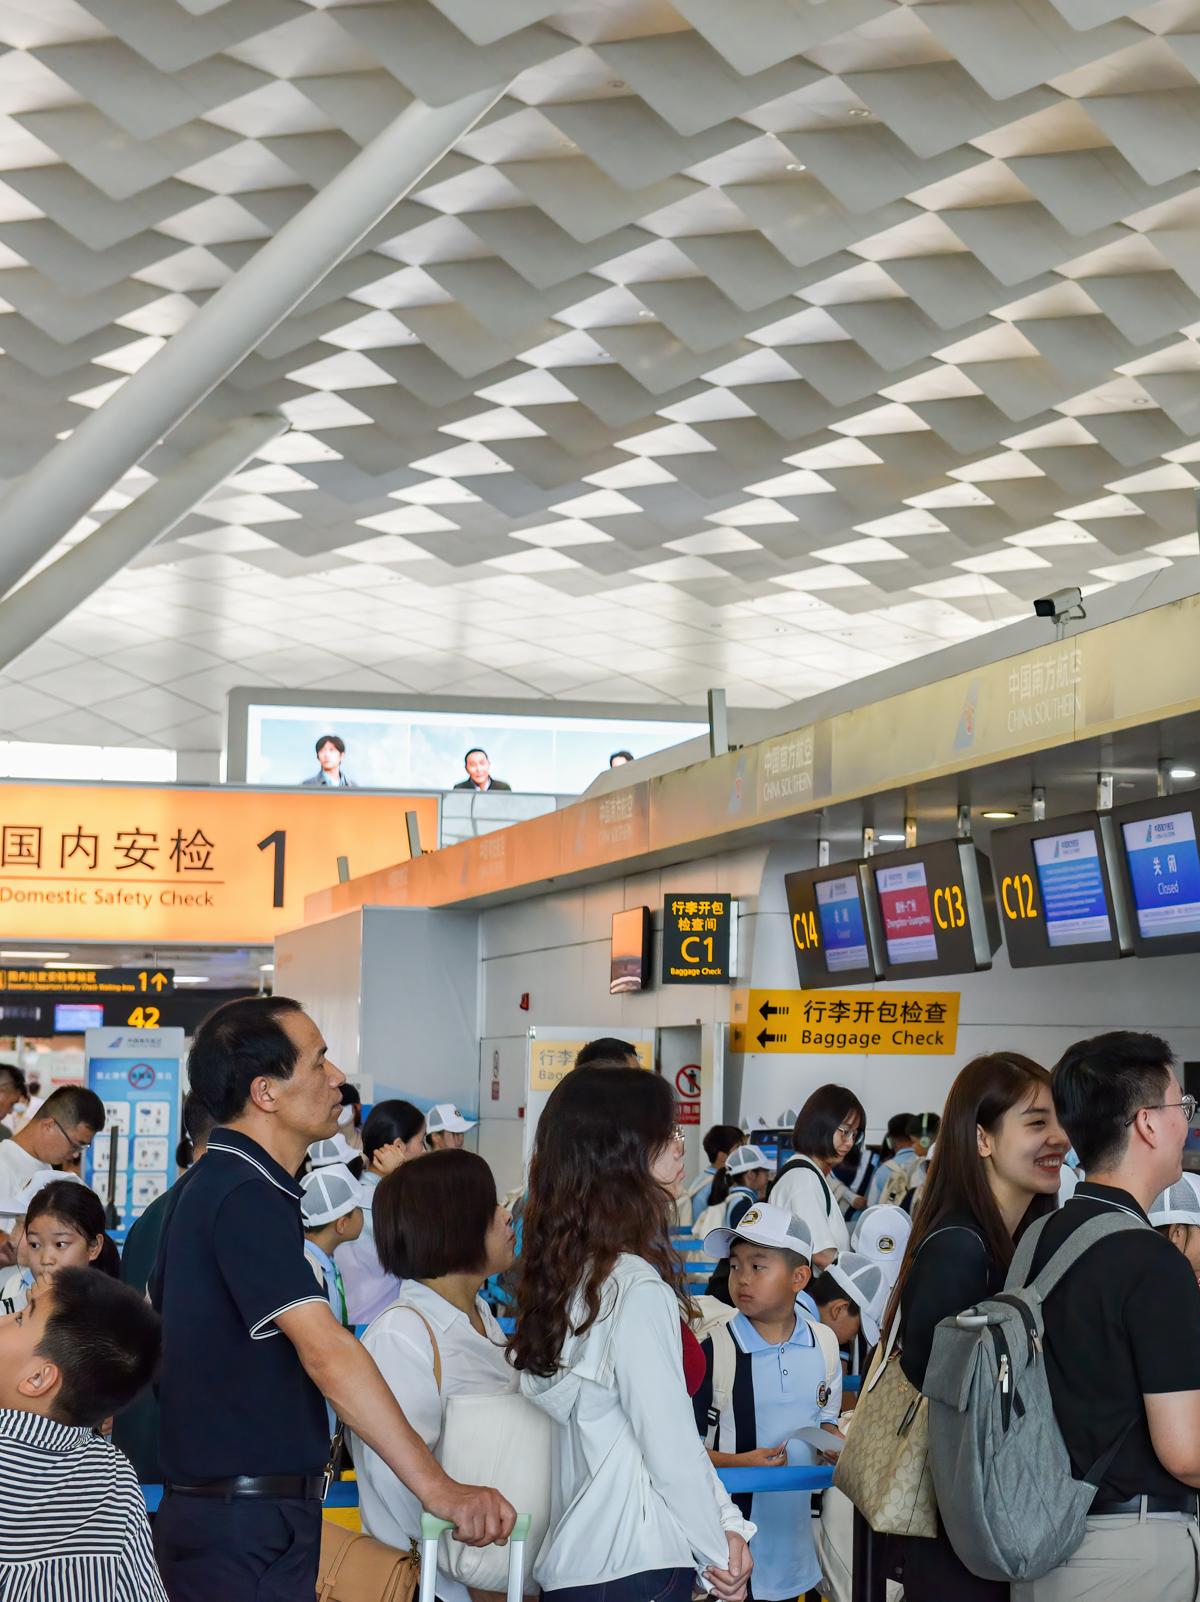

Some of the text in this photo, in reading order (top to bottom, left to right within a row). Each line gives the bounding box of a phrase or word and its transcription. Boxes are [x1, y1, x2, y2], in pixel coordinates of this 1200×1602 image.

[1008, 649, 1083, 704] 中国南方航空
[1007, 693, 1082, 733] CHINA SOUTHERN
[1, 824, 215, 873] 国内安检
[257, 830, 286, 908] 1
[0, 887, 214, 909] Domestic Safety Check
[1002, 873, 1038, 920] C12
[1157, 881, 1179, 895] Closed
[671, 900, 725, 916] 行李开包
[933, 885, 966, 930] C13
[678, 918, 717, 932] 检查间
[793, 910, 818, 950] C14
[680, 936, 714, 963] C1
[138, 971, 148, 992] 1
[670, 966, 722, 978] Baggage Check
[127, 1006, 161, 1029] 42
[803, 999, 948, 1024] 行李开包检查
[801, 1030, 944, 1048] Baggage Check
